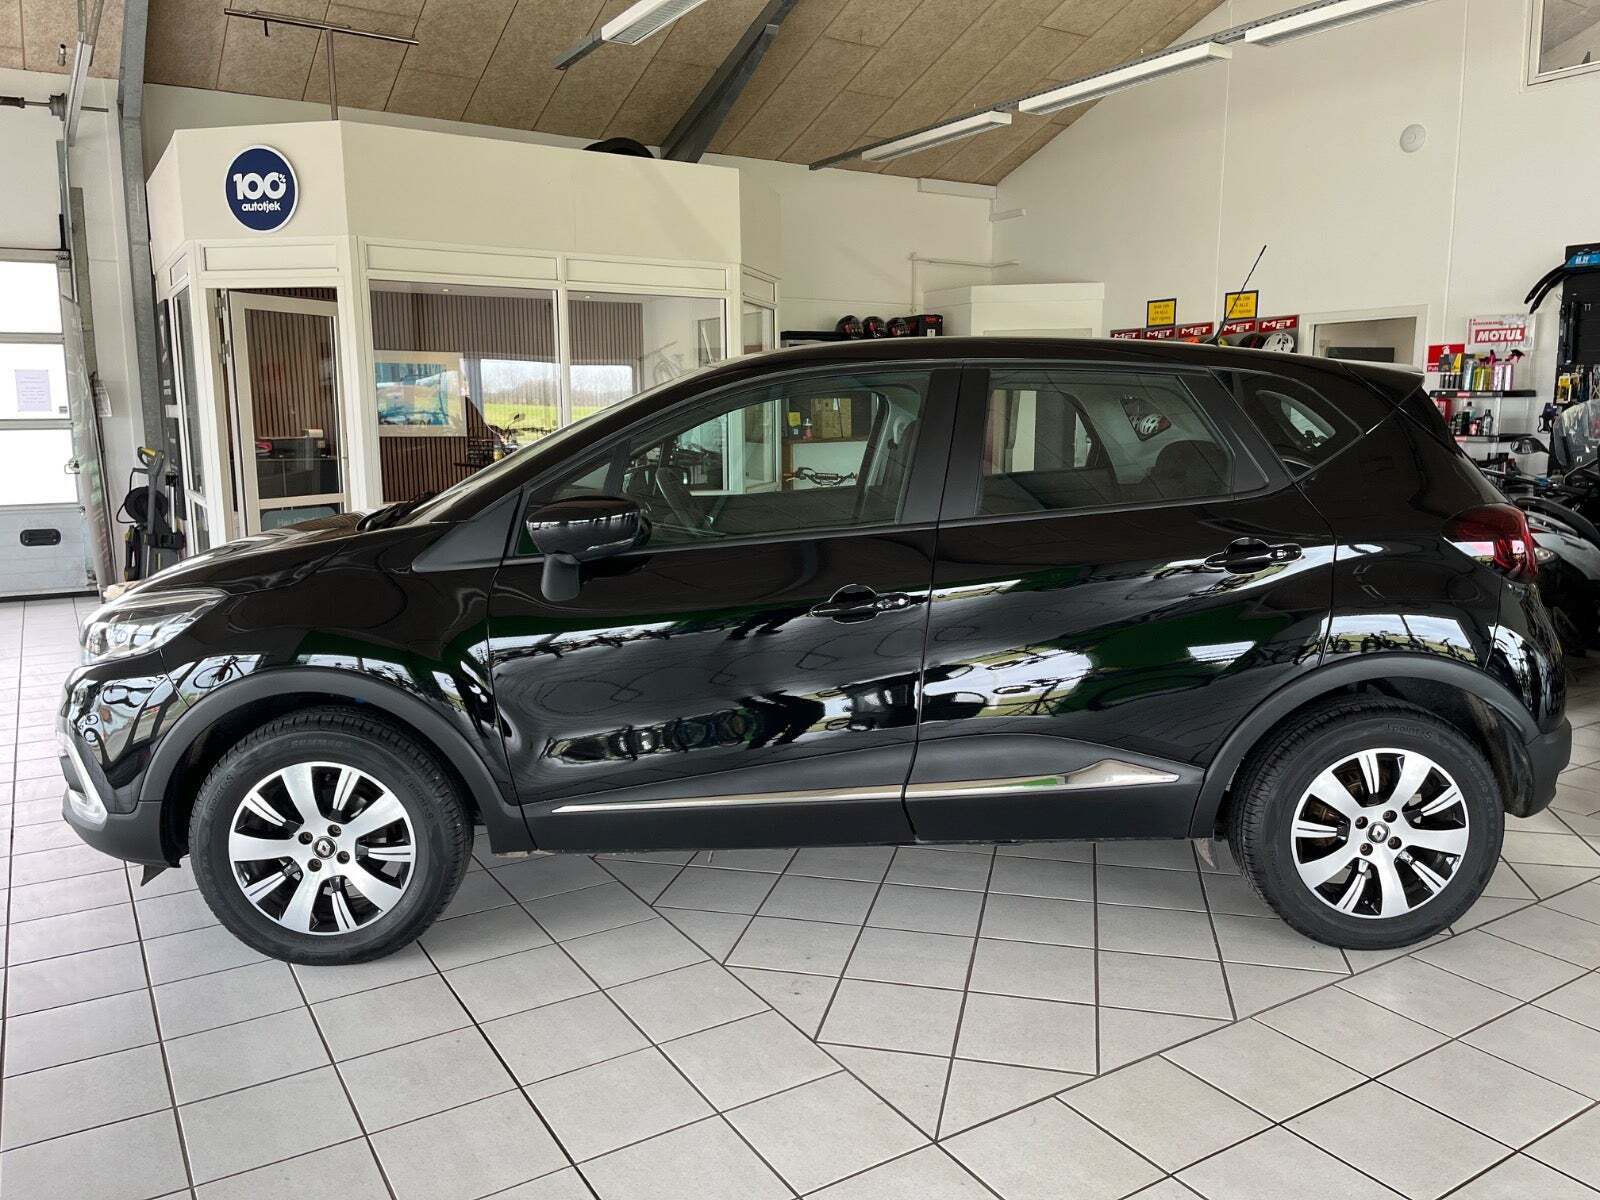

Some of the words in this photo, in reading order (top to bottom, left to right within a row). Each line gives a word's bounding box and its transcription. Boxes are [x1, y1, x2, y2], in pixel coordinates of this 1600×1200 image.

[241, 200, 281, 213] autotjek
[1224, 322, 1253, 333] MET
[1262, 318, 1294, 329] MET
[1144, 329, 1173, 339] MET
[1181, 325, 1210, 336] MET
[1476, 329, 1523, 341] MOTUL
